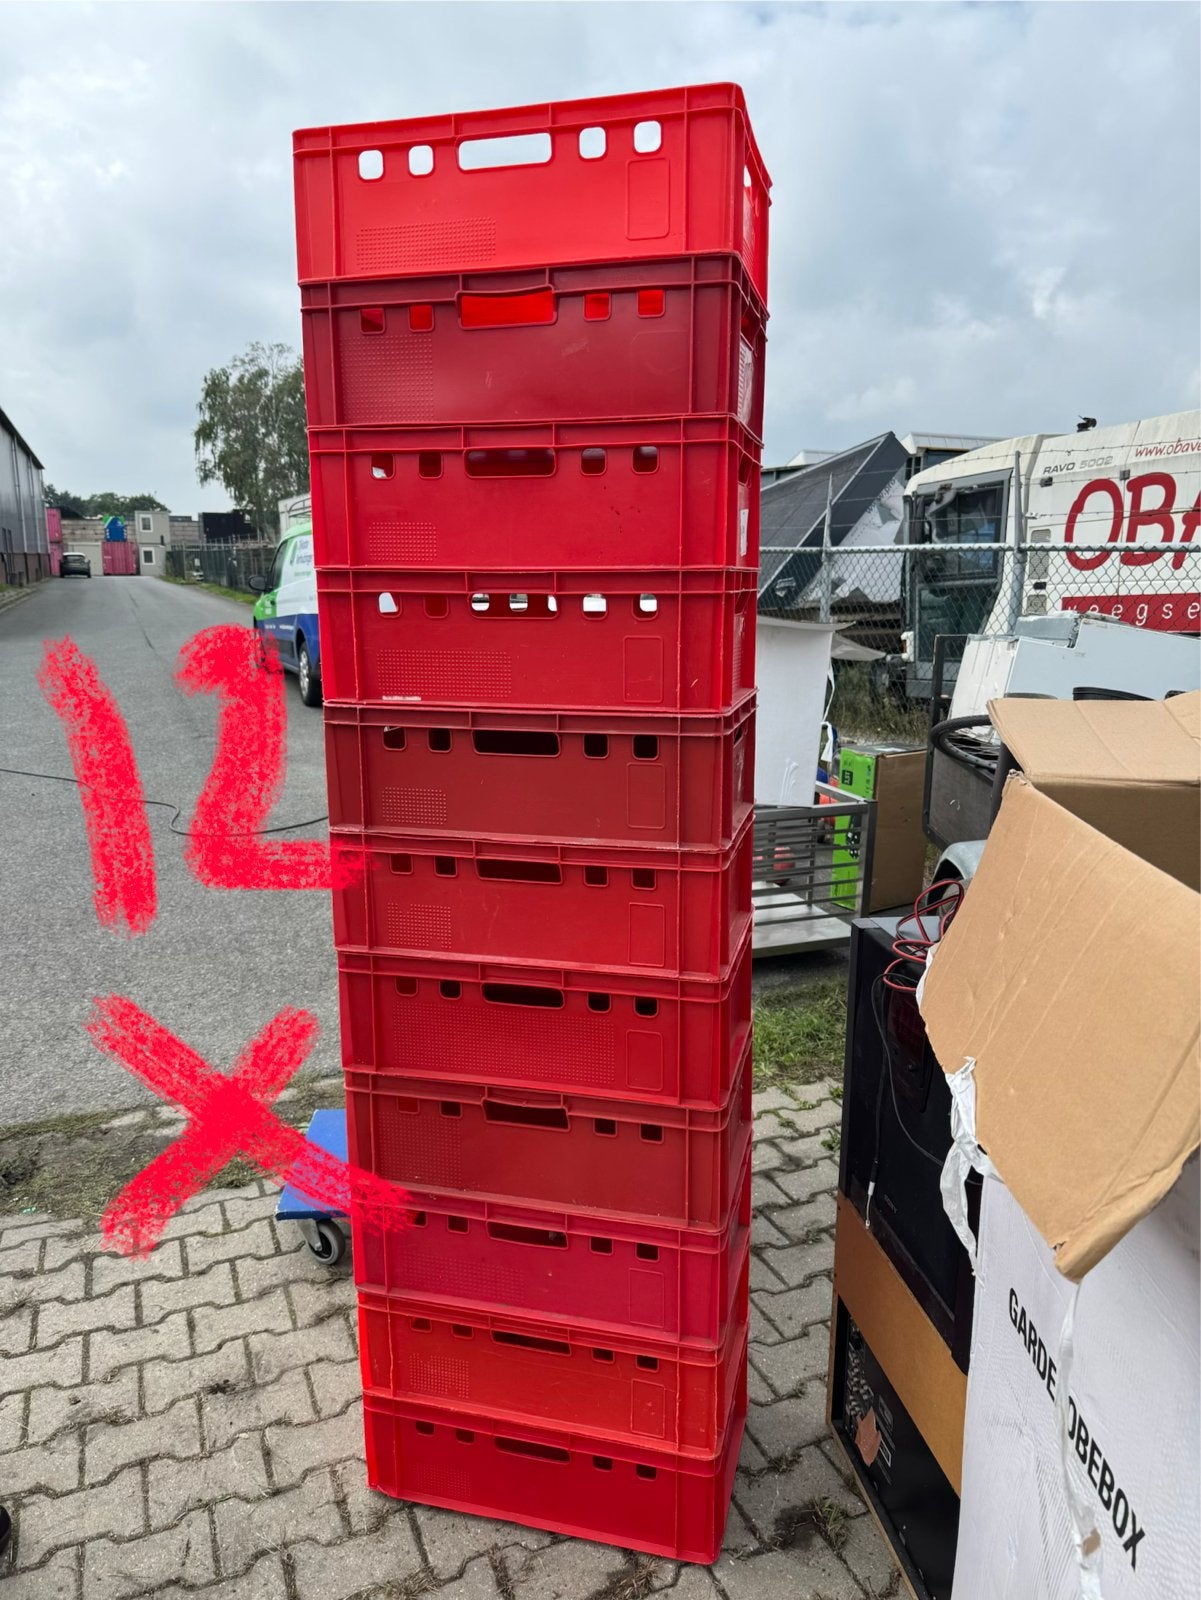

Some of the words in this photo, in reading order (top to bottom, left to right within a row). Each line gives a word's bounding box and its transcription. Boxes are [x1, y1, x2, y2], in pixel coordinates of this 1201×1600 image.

[1042, 462, 1076, 475] RAVO
[1080, 455, 1114, 469] 5002
[1008, 1287, 1146, 1572] GARDEOBEBOX
